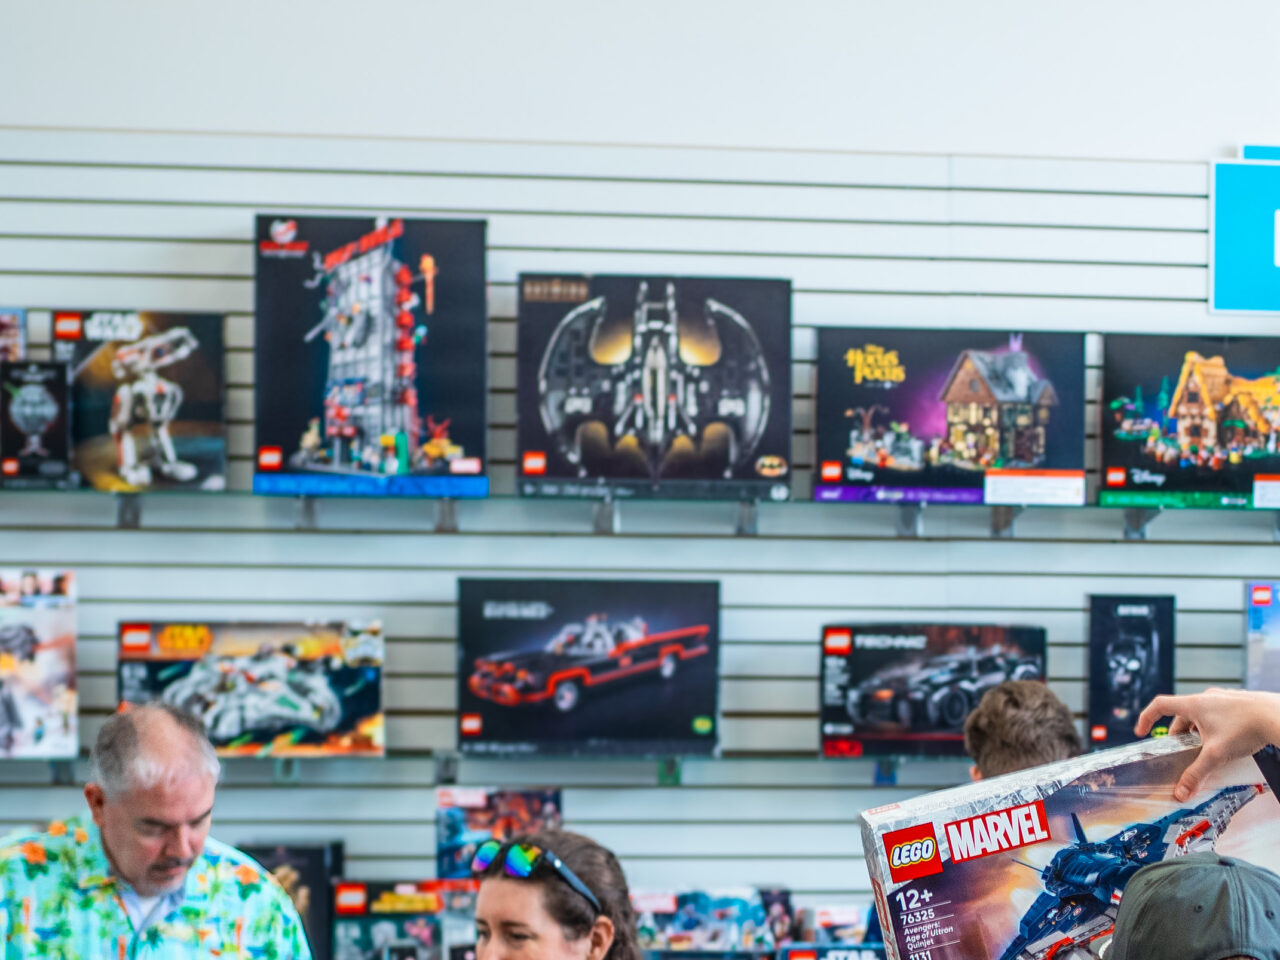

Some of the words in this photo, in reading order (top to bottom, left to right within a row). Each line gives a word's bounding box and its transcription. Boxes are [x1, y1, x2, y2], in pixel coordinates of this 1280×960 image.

[892, 838, 935, 867] LEGO
[947, 803, 1047, 861] MARVEL
[896, 889, 933, 911] 12+
[900, 908, 935, 926] 76325
[904, 921, 941, 936] Avengers:
[906, 934, 920, 943] Age
[921, 932, 929, 940] of
[930, 926, 954, 937] Ultron
[907, 938, 934, 951] Quinjet
